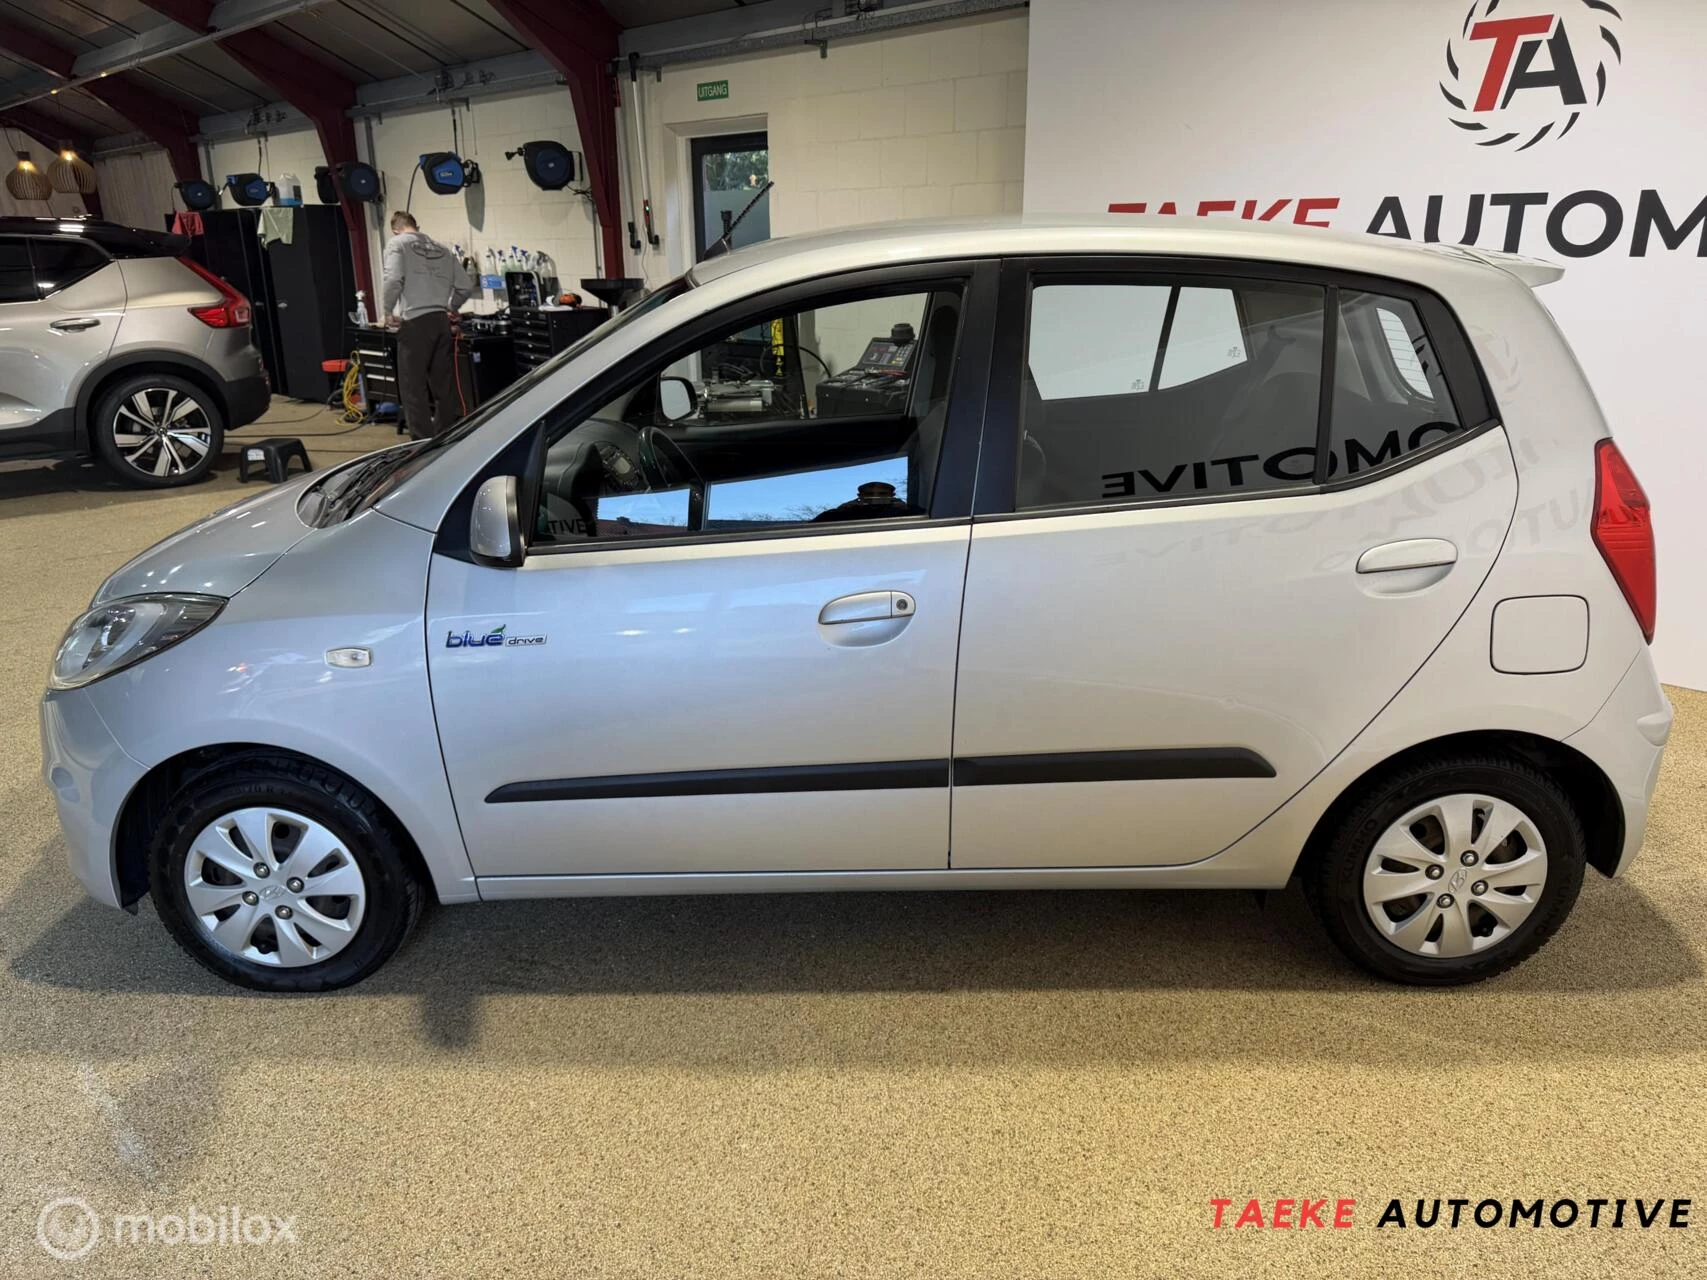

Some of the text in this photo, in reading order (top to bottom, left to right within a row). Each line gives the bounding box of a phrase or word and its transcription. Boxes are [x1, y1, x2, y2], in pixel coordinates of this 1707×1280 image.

[1469, 14, 1588, 112] TA
[698, 83, 728, 98] UITGANG
[445, 629, 545, 648] blue drive
